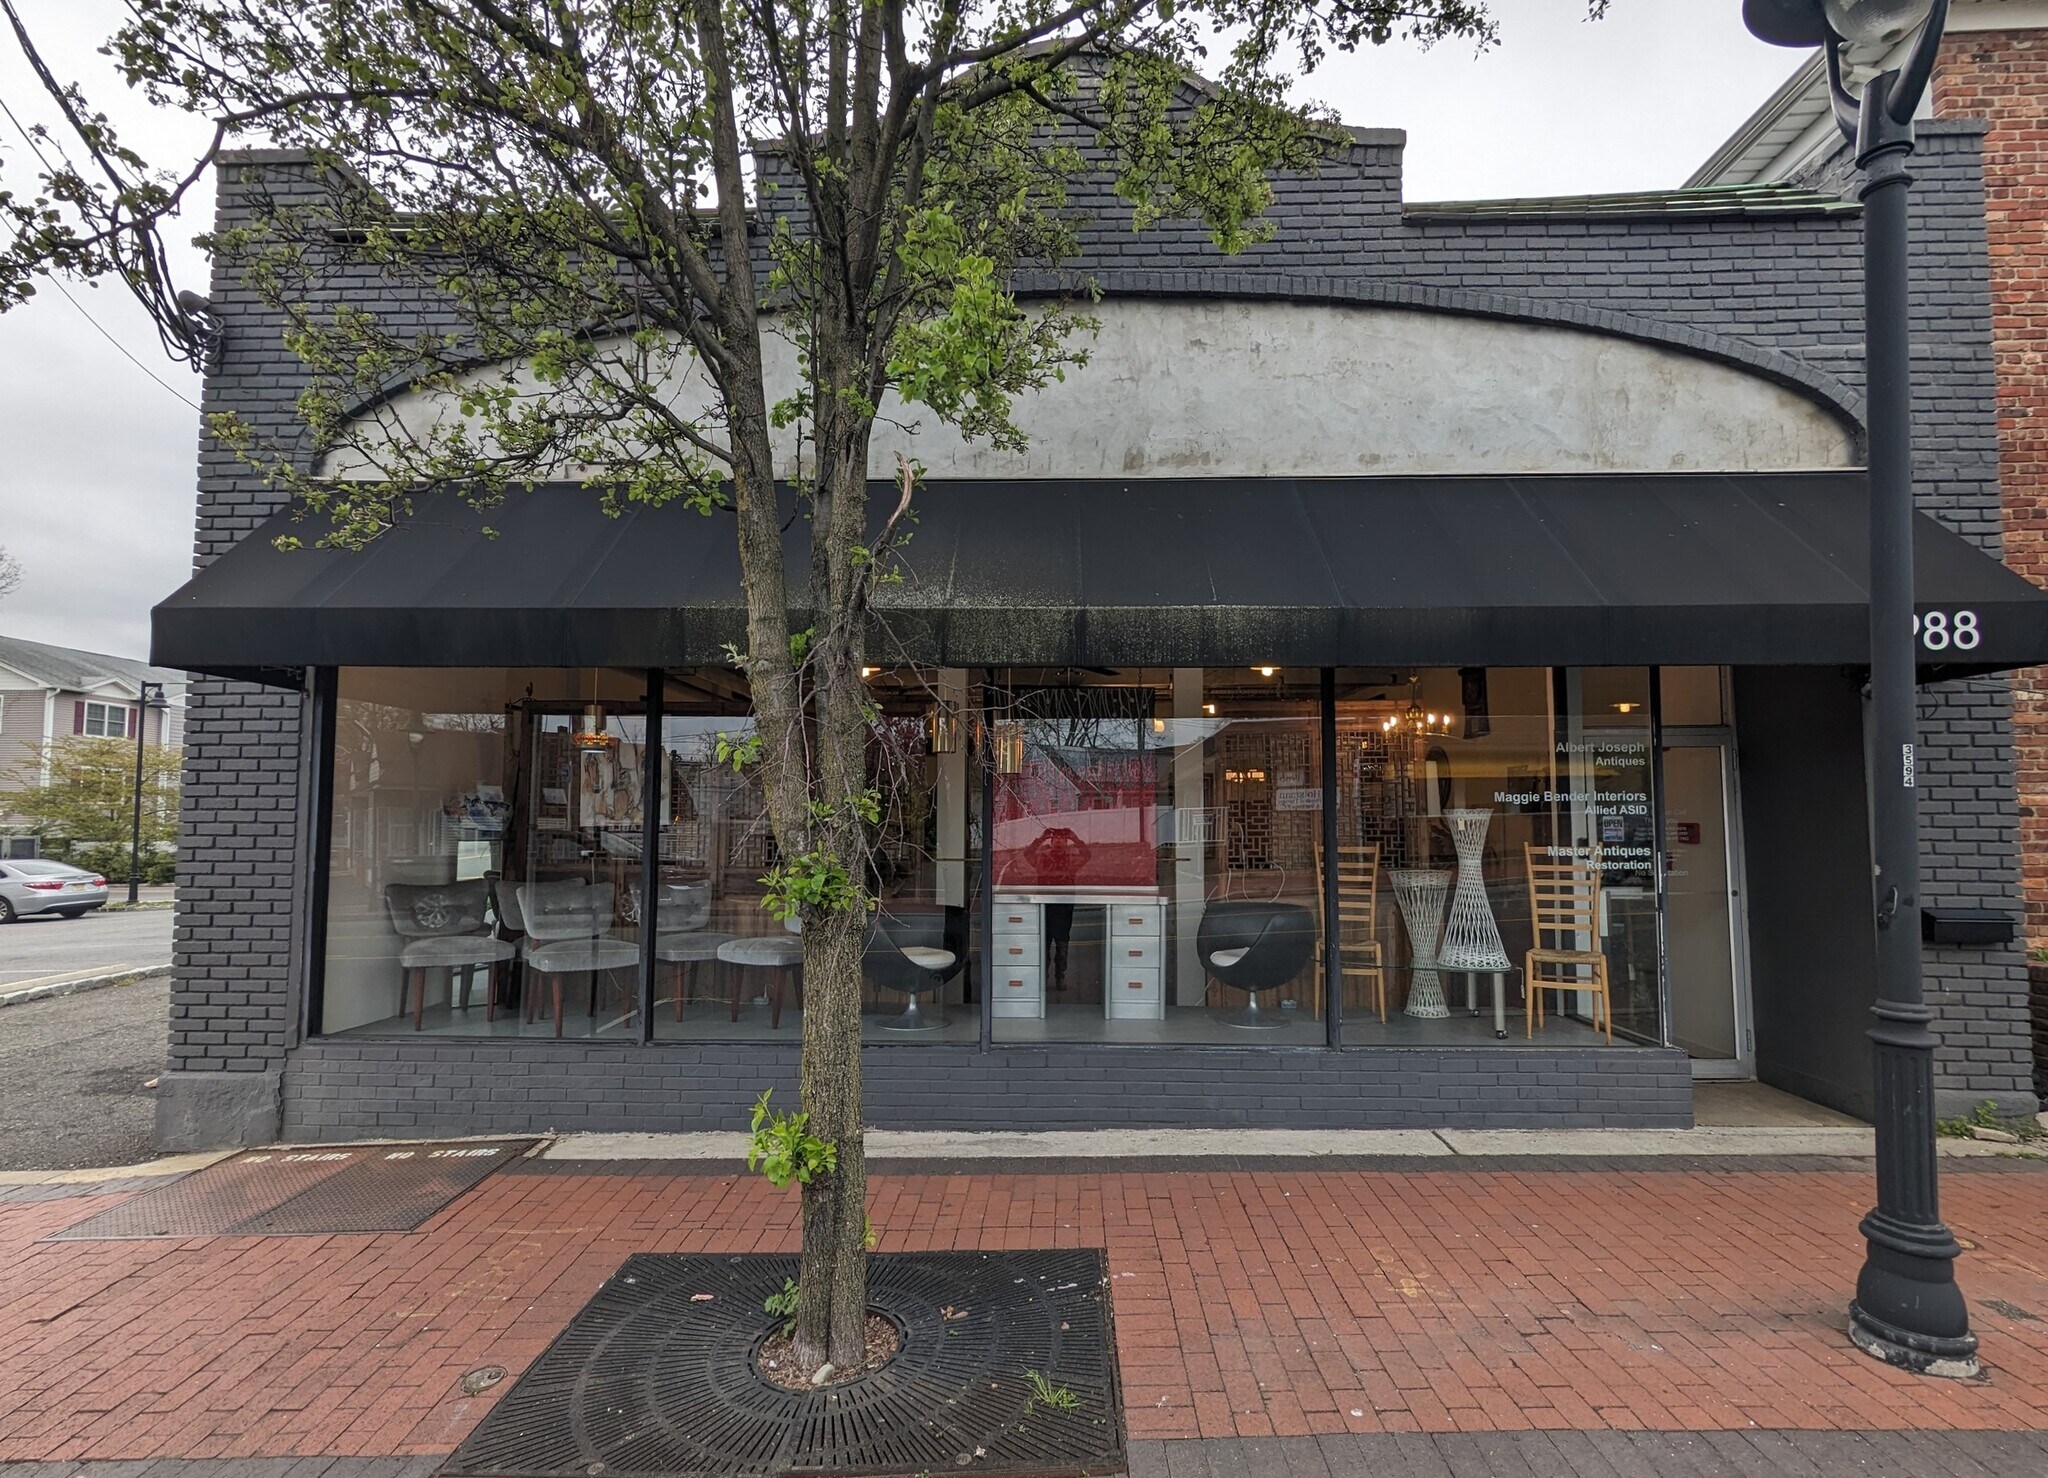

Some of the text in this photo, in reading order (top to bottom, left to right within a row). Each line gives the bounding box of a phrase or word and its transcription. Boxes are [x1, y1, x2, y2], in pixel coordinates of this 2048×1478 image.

[1913, 610, 1980, 650] 88
[1556, 742, 1645, 755] Albert Joseph
[1596, 756, 1646, 768] Antiques
[1903, 744, 1914, 787] 3594
[1494, 790, 1647, 804] Maggie Bender Interiors
[1585, 805, 1647, 815] Allied ASID
[1604, 818, 1623, 828] OPEN
[1547, 845, 1651, 858] Master Antiques
[1586, 859, 1652, 870] Restoration
[239, 1153, 353, 1163] NO STAIRS
[384, 1148, 500, 1160] NO STAIRS
